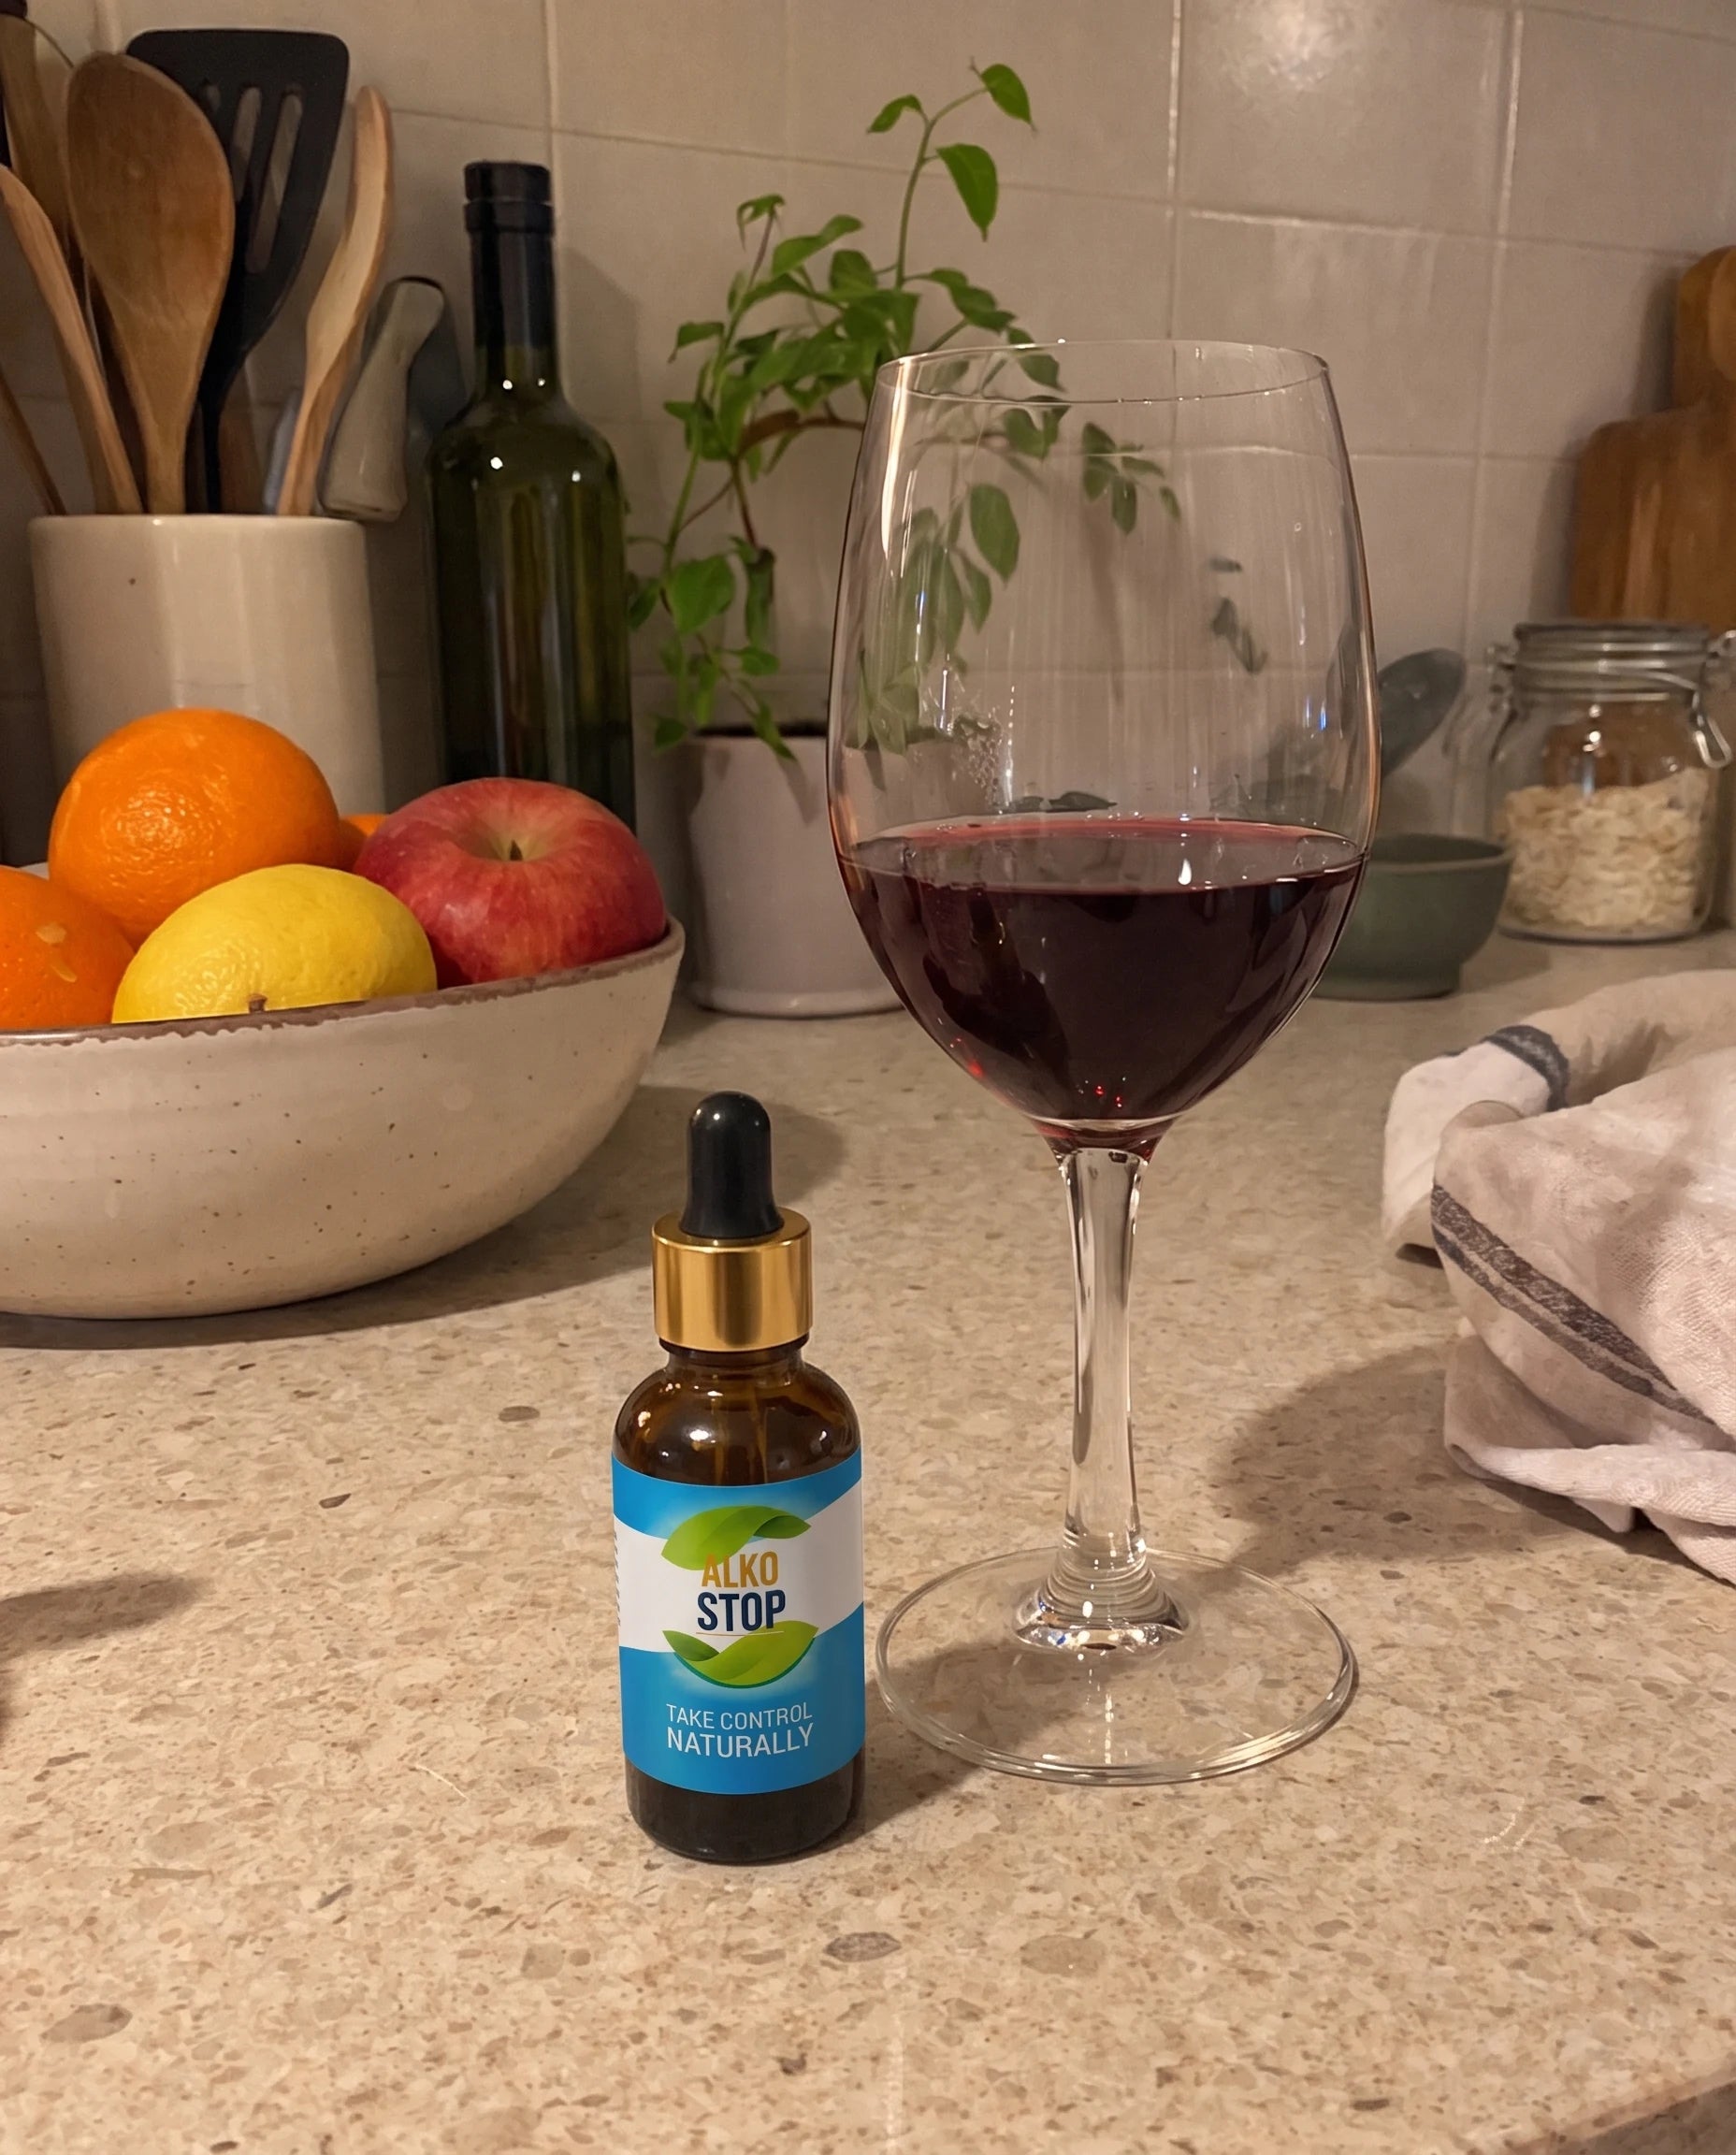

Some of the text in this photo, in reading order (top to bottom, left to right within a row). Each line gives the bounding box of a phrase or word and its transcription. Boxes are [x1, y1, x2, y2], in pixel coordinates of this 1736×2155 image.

[702, 1551, 778, 1588] ALKO
[697, 1589, 786, 1632] STOP
[666, 1702, 813, 1729] TAKE CONTROL
[667, 1723, 814, 1757] NATURALLY
